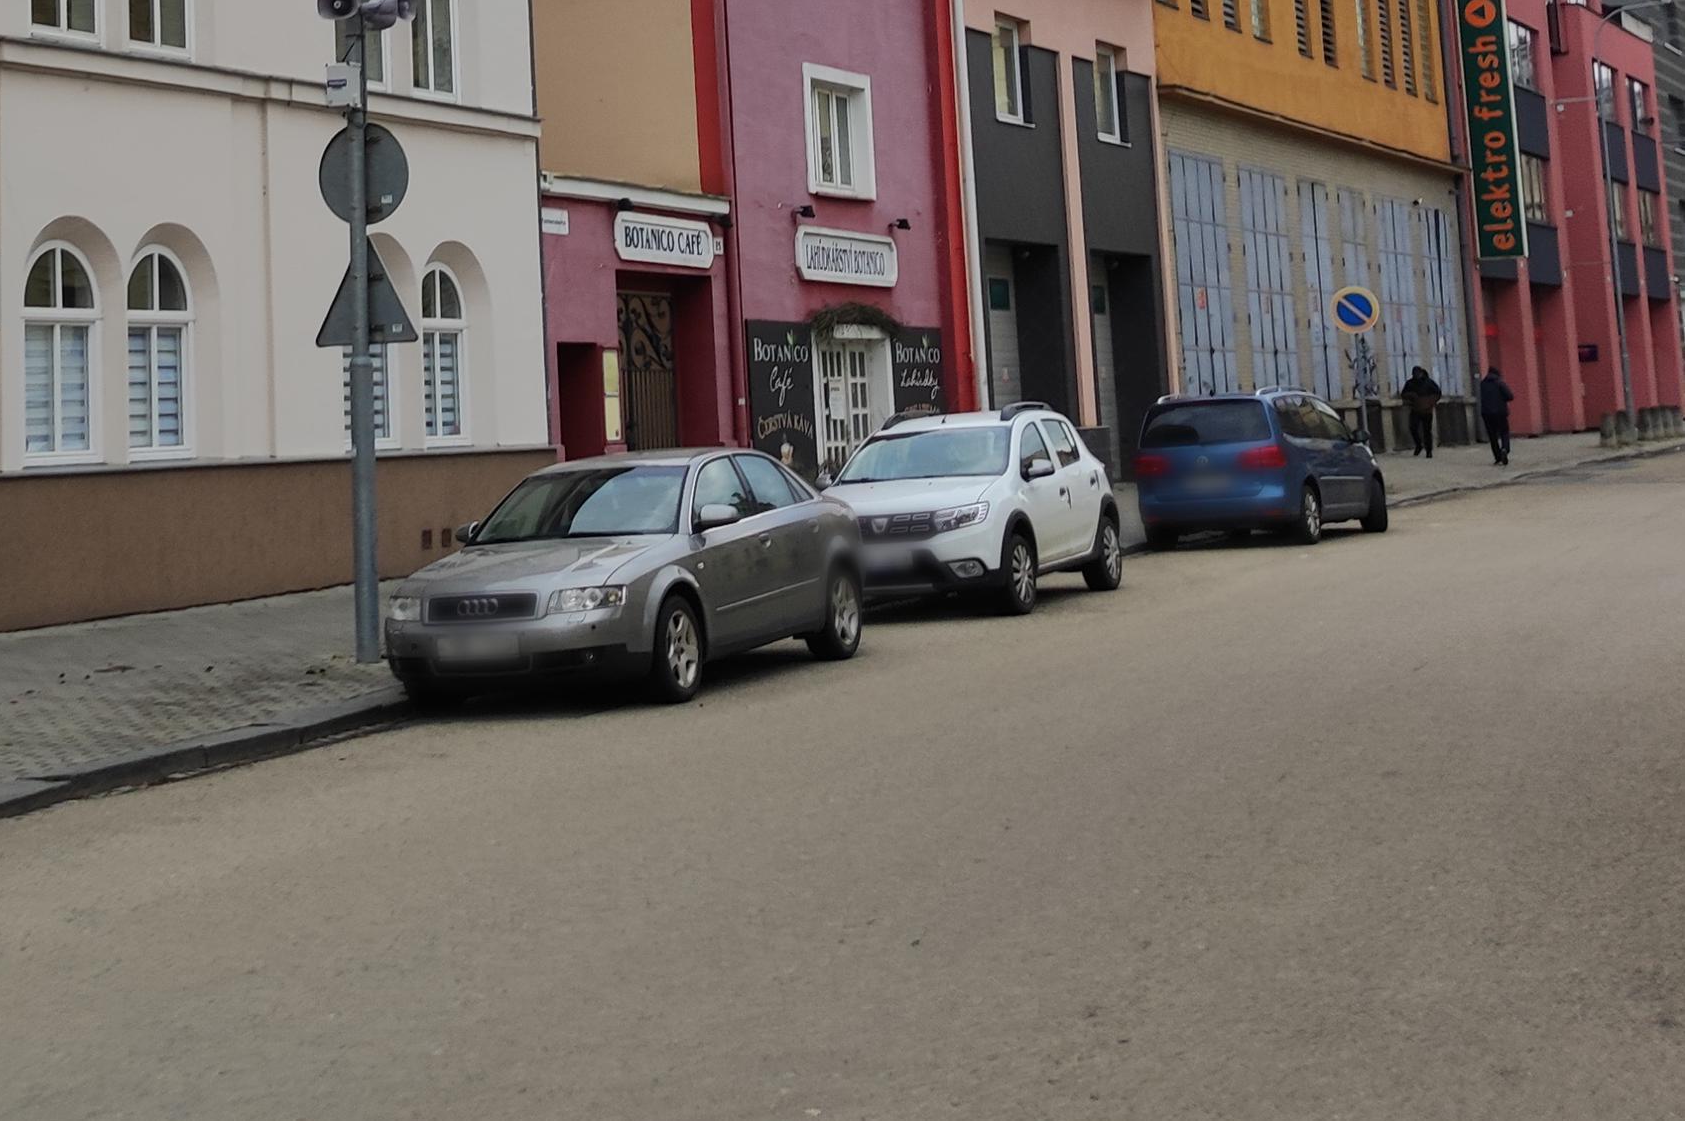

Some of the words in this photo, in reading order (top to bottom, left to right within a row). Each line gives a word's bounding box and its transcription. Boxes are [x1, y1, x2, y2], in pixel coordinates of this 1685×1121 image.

[1468, 35, 1503, 121] fresh
[1481, 130, 1516, 251] elektro
[624, 225, 675, 253] BOTANICO
[677, 230, 704, 256] CAFÉ
[854, 249, 886, 277] BOTANICO
[769, 365, 794, 408] Café
[793, 414, 814, 440] KÁVA
